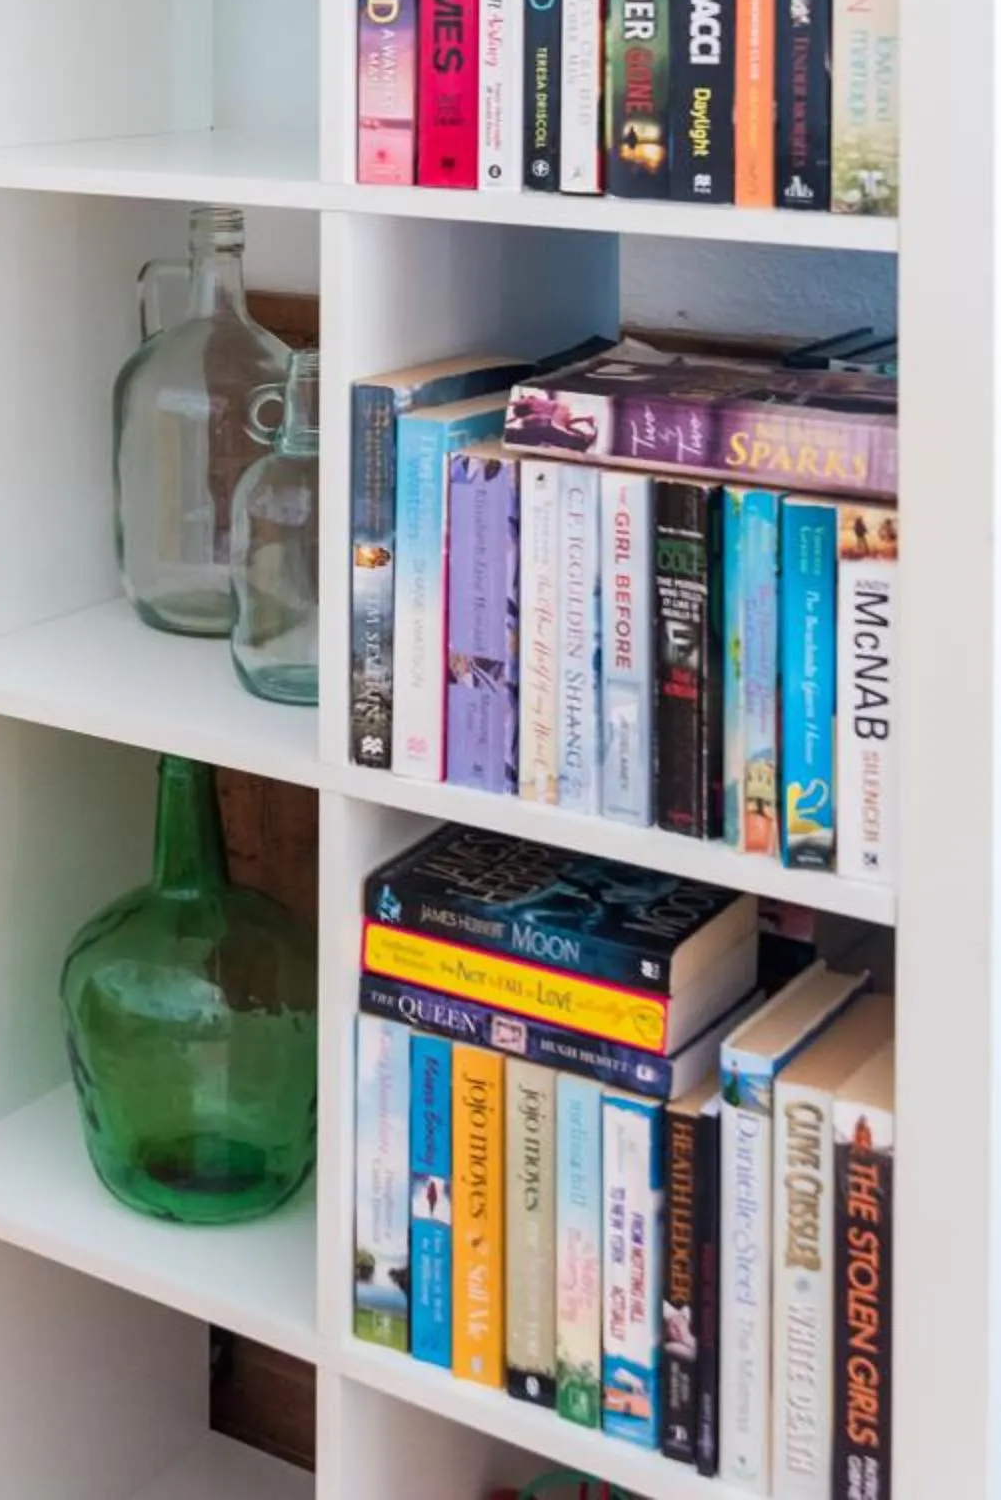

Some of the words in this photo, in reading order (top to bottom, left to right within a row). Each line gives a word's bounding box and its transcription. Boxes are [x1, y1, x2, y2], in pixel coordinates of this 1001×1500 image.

[535, 46, 548, 89] TERESA
[625, 46, 654, 113] GONE
[535, 92, 548, 149] DRISCOLL
[692, 86, 712, 157] Daylight
[613, 510, 632, 564] GIRL
[566, 536, 586, 659] IGGULDEN
[614, 573, 633, 670] BEFORE
[854, 590, 890, 742] McNAB
[564, 668, 587, 770] SHIANG
[861, 750, 880, 843] SILENCER
[420, 902, 457, 928] JAMES
[510, 922, 581, 965] MOON
[397, 993, 478, 1034] QUEEN
[462, 1075, 495, 1130] jojo
[517, 1083, 550, 1133] jojo
[784, 1102, 825, 1167] CLIVE
[465, 1132, 489, 1220] moyes
[518, 1137, 543, 1213] moyes
[670, 1120, 695, 1206] HEATH
[733, 1113, 762, 1233] Danielle
[847, 1161, 880, 1224] THE
[670, 1206, 693, 1302] LEDGER
[784, 1166, 824, 1273] CUSSLER
[731, 1233, 761, 1307] Steel
[847, 1226, 880, 1355] STOLEN
[609, 1284, 626, 1344] ACTUALLY
[788, 1302, 818, 1384] WHITE
[787, 1395, 817, 1476] DEATH
[846, 1356, 880, 1448] GIRLS
